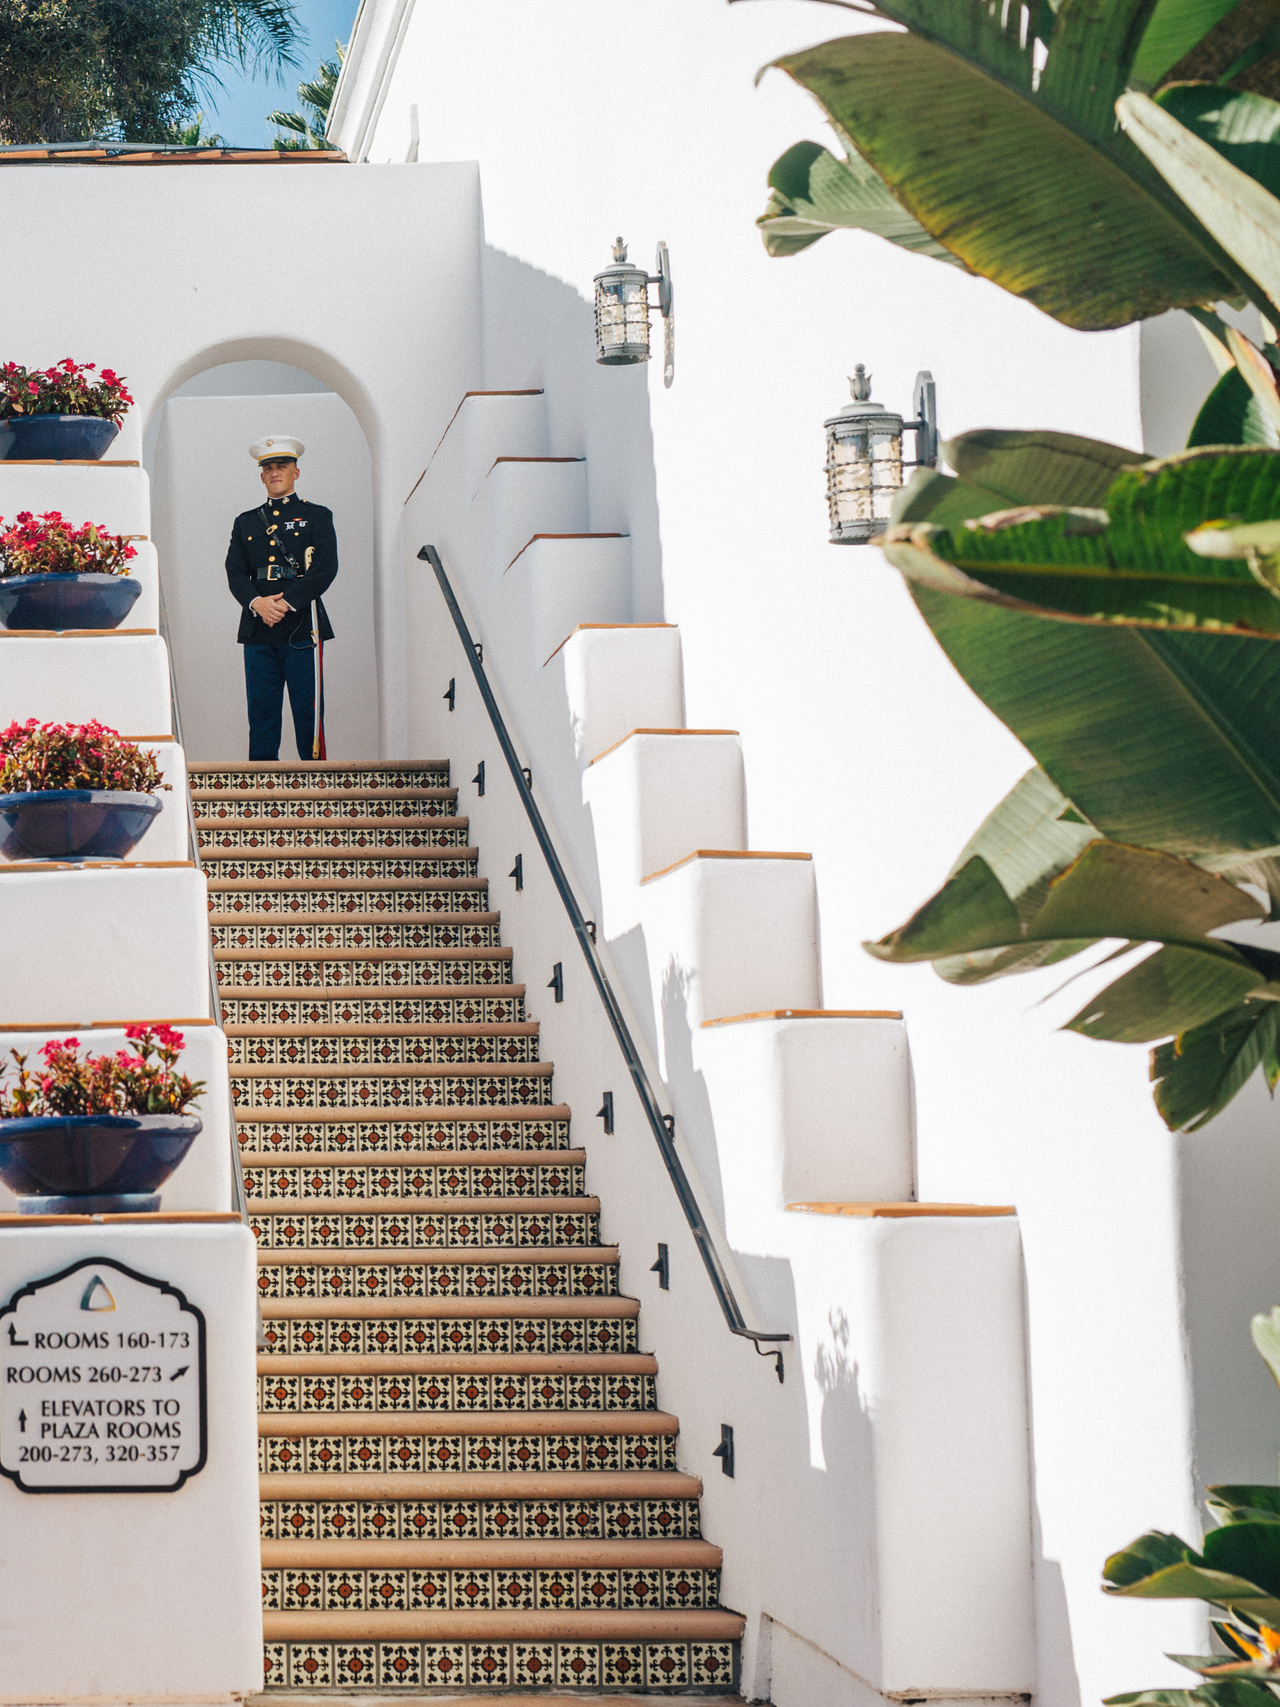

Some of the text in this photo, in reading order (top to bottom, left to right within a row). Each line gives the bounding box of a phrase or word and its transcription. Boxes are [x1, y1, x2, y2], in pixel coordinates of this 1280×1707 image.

[35, 1332, 190, 1349] ROOMS 160-173
[7, 1366, 162, 1383] ROOMS 260-273
[41, 1399, 180, 1417] ELEVATORS TO
[41, 1422, 181, 1439] PLAZA ROOMS
[19, 1445, 180, 1464] 200-273, 320-357
